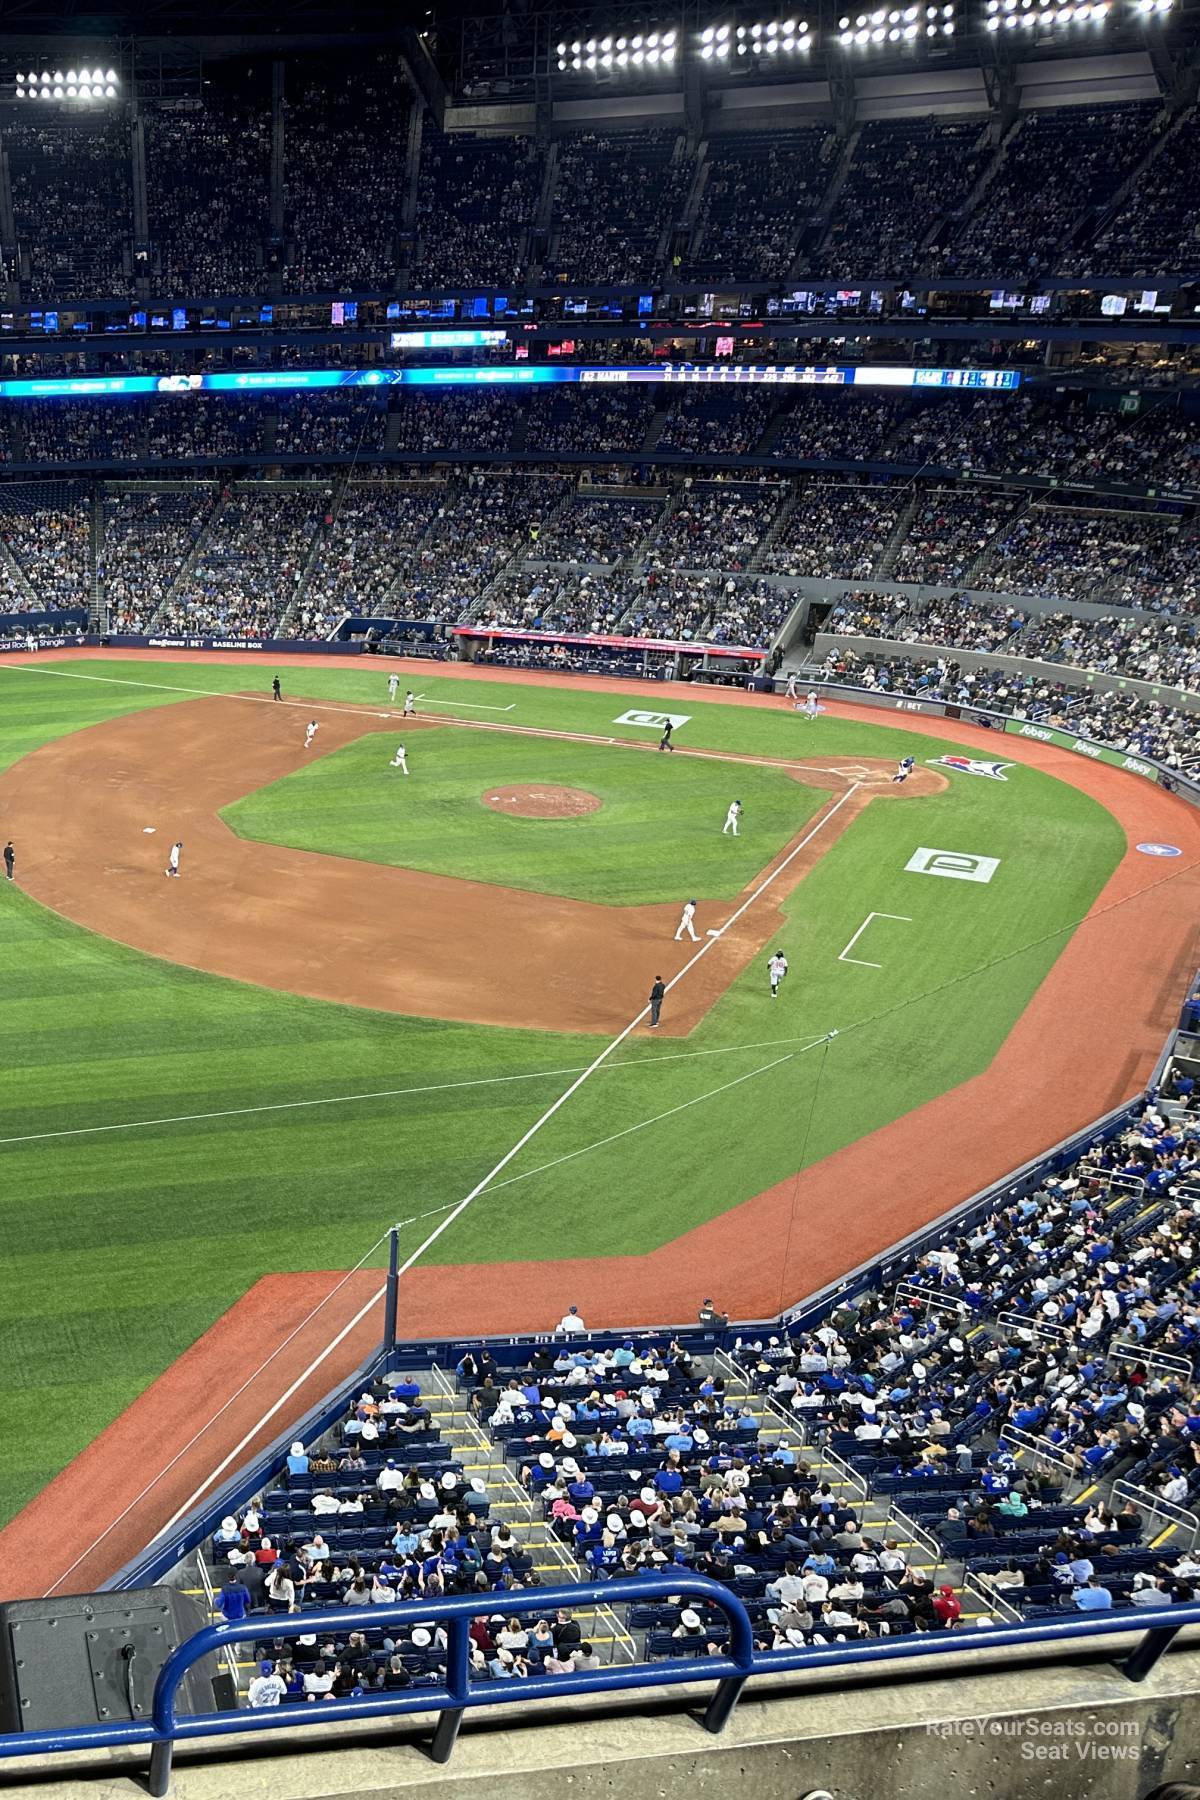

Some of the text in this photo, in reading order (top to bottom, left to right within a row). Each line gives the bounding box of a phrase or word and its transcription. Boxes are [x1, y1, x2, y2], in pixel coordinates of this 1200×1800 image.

[40, 638, 66, 648] Shingle
[190, 640, 204, 648] BET
[906, 702, 922, 711] BET
[1018, 724, 1054, 742] Sobeys
[1072, 739, 1102, 757] Sobeys
[1122, 756, 1152, 776] Sobeys
[991, 1476, 1009, 1488] 29
[262, 1691, 279, 1704] 27
